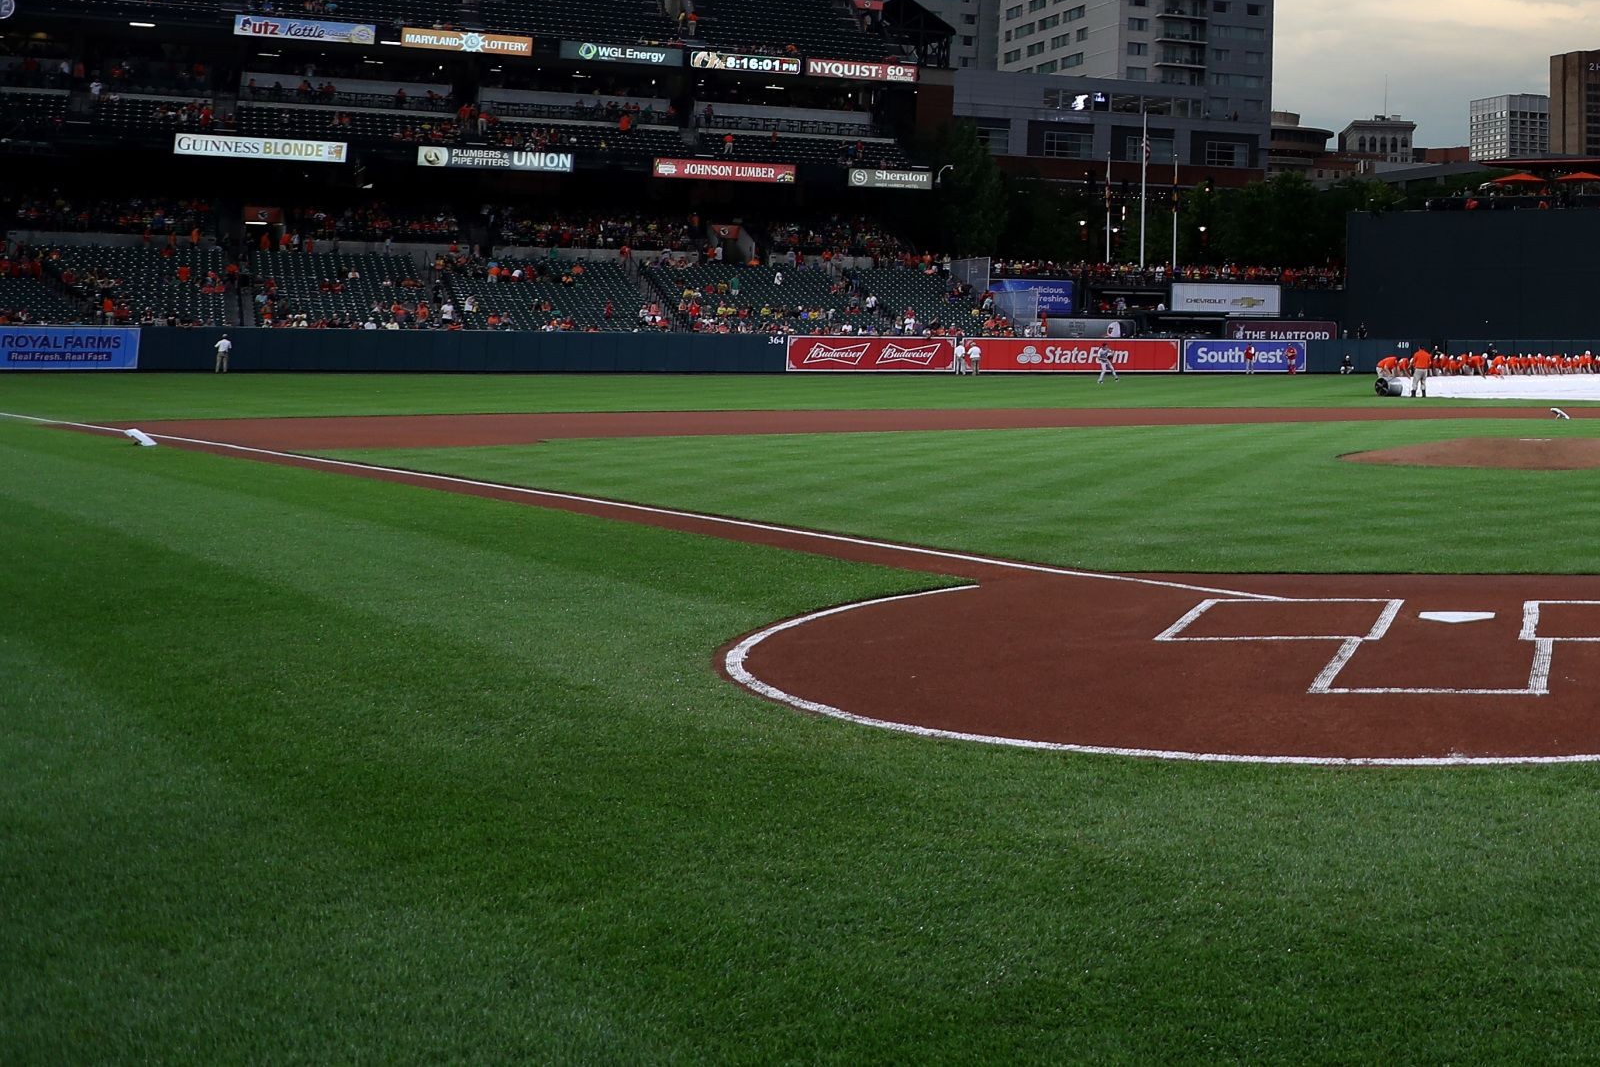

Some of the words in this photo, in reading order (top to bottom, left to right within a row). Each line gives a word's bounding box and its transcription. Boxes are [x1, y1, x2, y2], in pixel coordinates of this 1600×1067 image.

[285, 23, 325, 38] Kettle
[405, 34, 459, 47] MARYLAND
[598, 47, 625, 59] WGL
[626, 48, 666, 63] Energy
[726, 56, 780, 71] 8:16:01
[783, 62, 798, 72] PM
[809, 61, 878, 77] NYQUIST
[1589, 63, 1595, 71] 2
[887, 65, 904, 76] 60
[177, 137, 260, 154] GUINNESS
[263, 141, 323, 157] BLONDE
[452, 149, 501, 158] PLUMBERS
[513, 151, 571, 167] UNION
[452, 157, 472, 165] PIPE
[474, 158, 510, 167] FITTERS
[684, 164, 733, 176] JOHNSON
[735, 166, 775, 179] LUMBER
[875, 170, 927, 181] Sheraton
[768, 336, 784, 344] 364
[1245, 331, 1262, 339] THE
[1270, 331, 1330, 340] HARTFORD
[2, 335, 62, 348] ROYAL
[64, 336, 121, 349] FARMS
[1397, 341, 1410, 349] 410
[35, 353, 62, 361] Fresh.
[65, 353, 85, 361] Real
[87, 353, 108, 361] Fast.
[810, 347, 863, 358] Budweiser
[882, 347, 933, 358] Budweiser
[1043, 346, 1128, 364] StateFm
